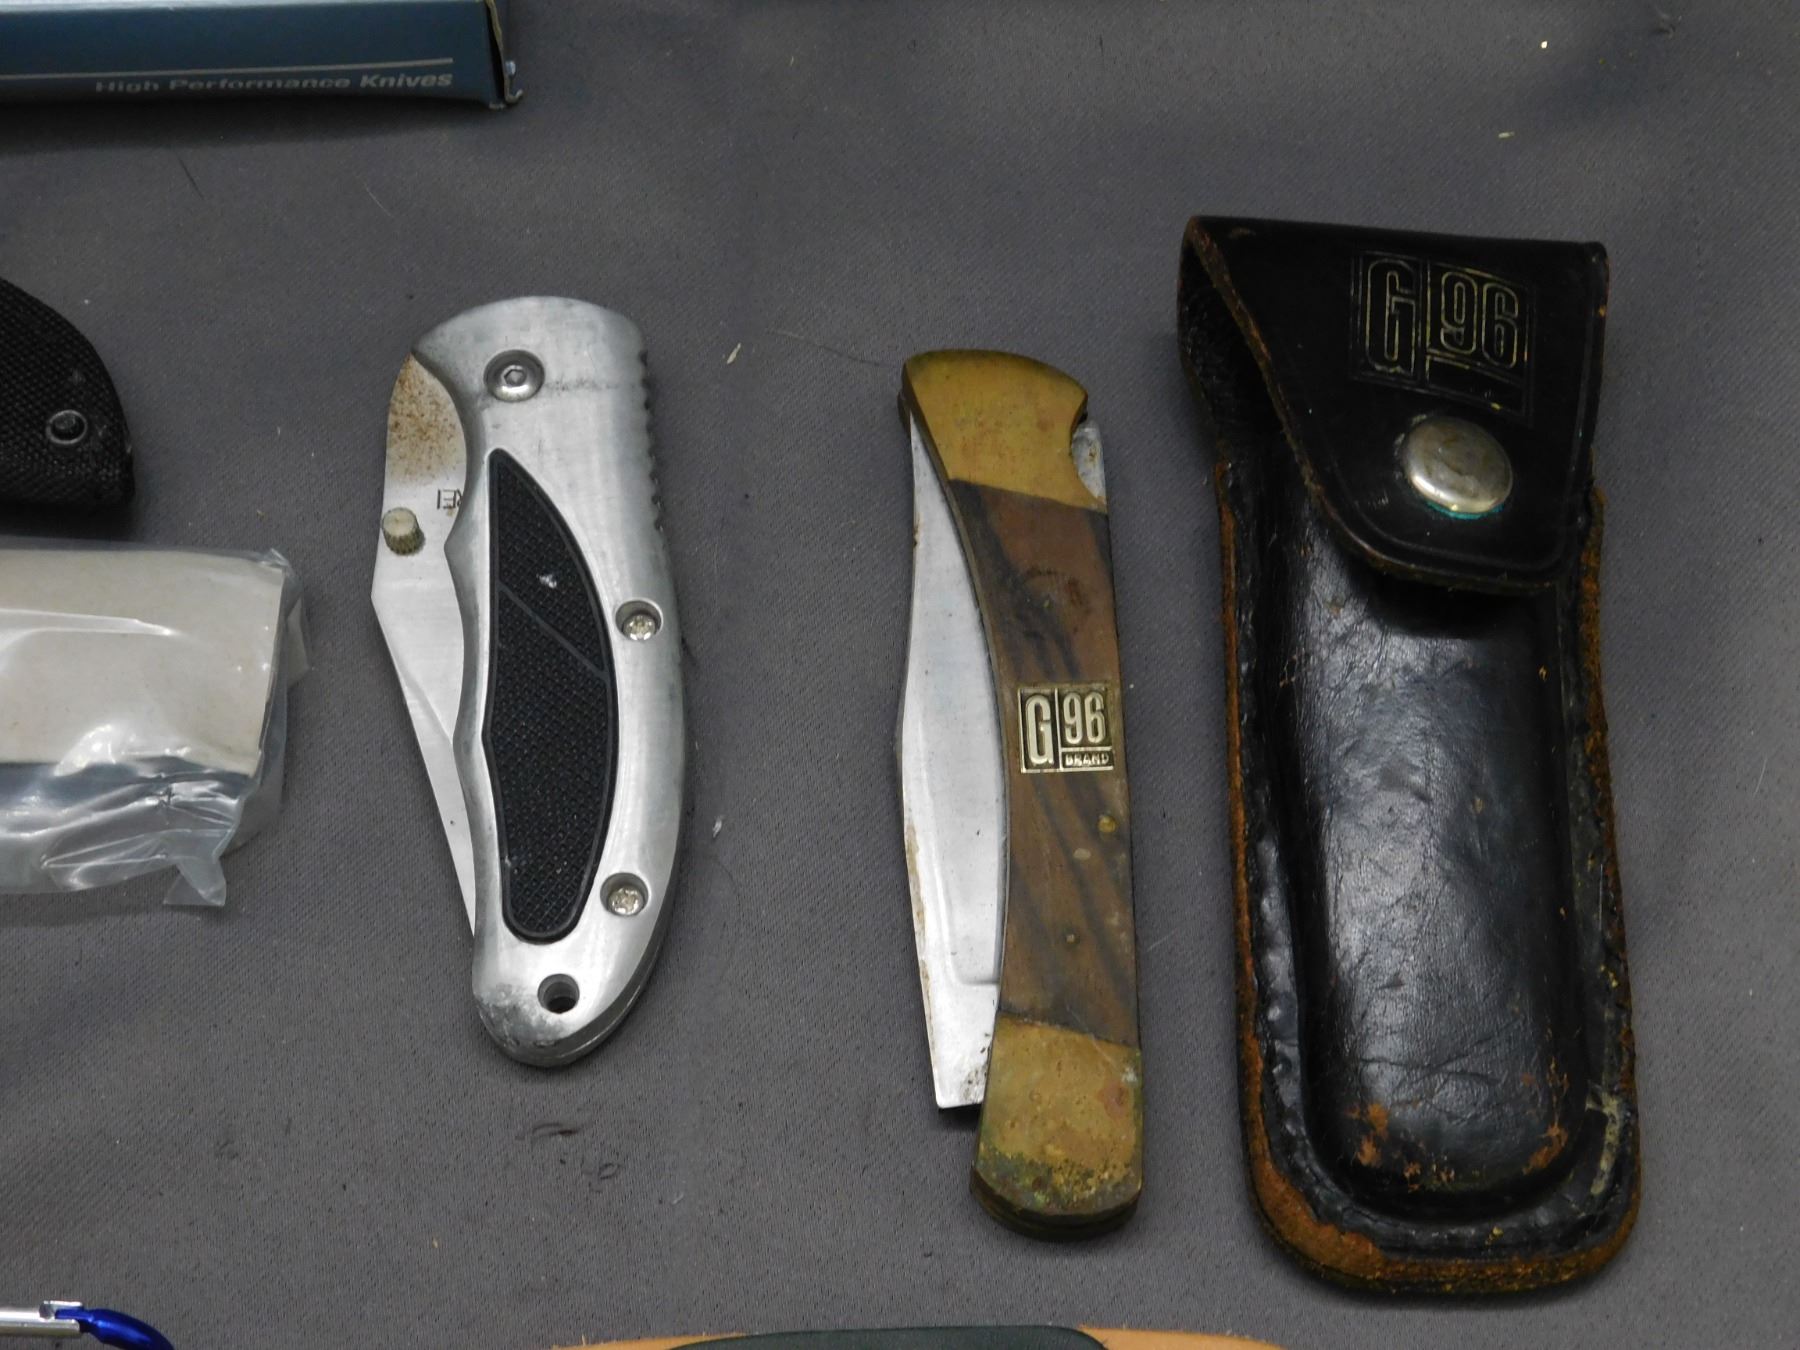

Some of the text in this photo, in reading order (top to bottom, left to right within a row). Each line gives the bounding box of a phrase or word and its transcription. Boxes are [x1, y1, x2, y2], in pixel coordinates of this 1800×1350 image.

[95, 72, 454, 94] High Performance Knives
[1064, 753, 1110, 767] BRAND
